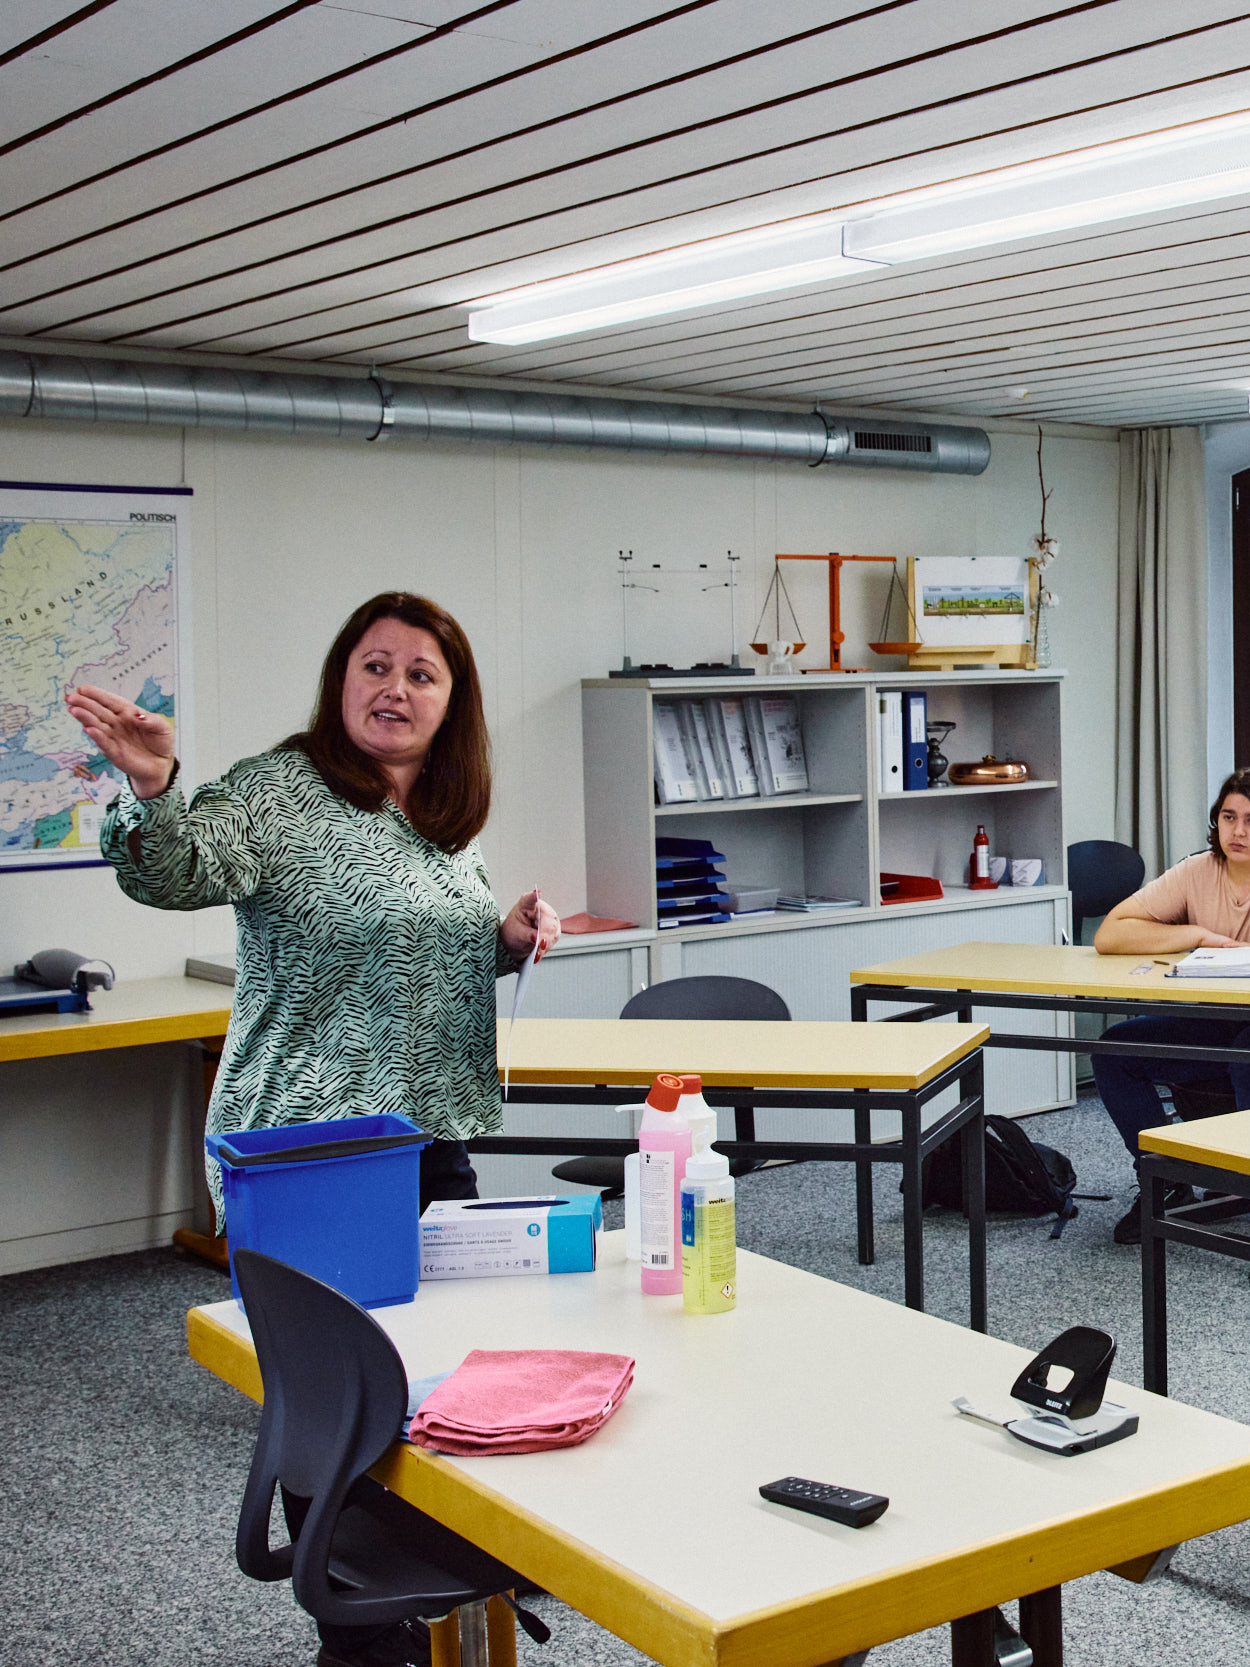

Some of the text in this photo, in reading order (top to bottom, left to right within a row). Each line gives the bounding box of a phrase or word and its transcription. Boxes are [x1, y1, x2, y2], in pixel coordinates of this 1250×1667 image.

[130, 512, 177, 521] POLITISCH
[5, 571, 108, 626] RUSSLAND
[482, 1230, 513, 1238] LAVENDER
